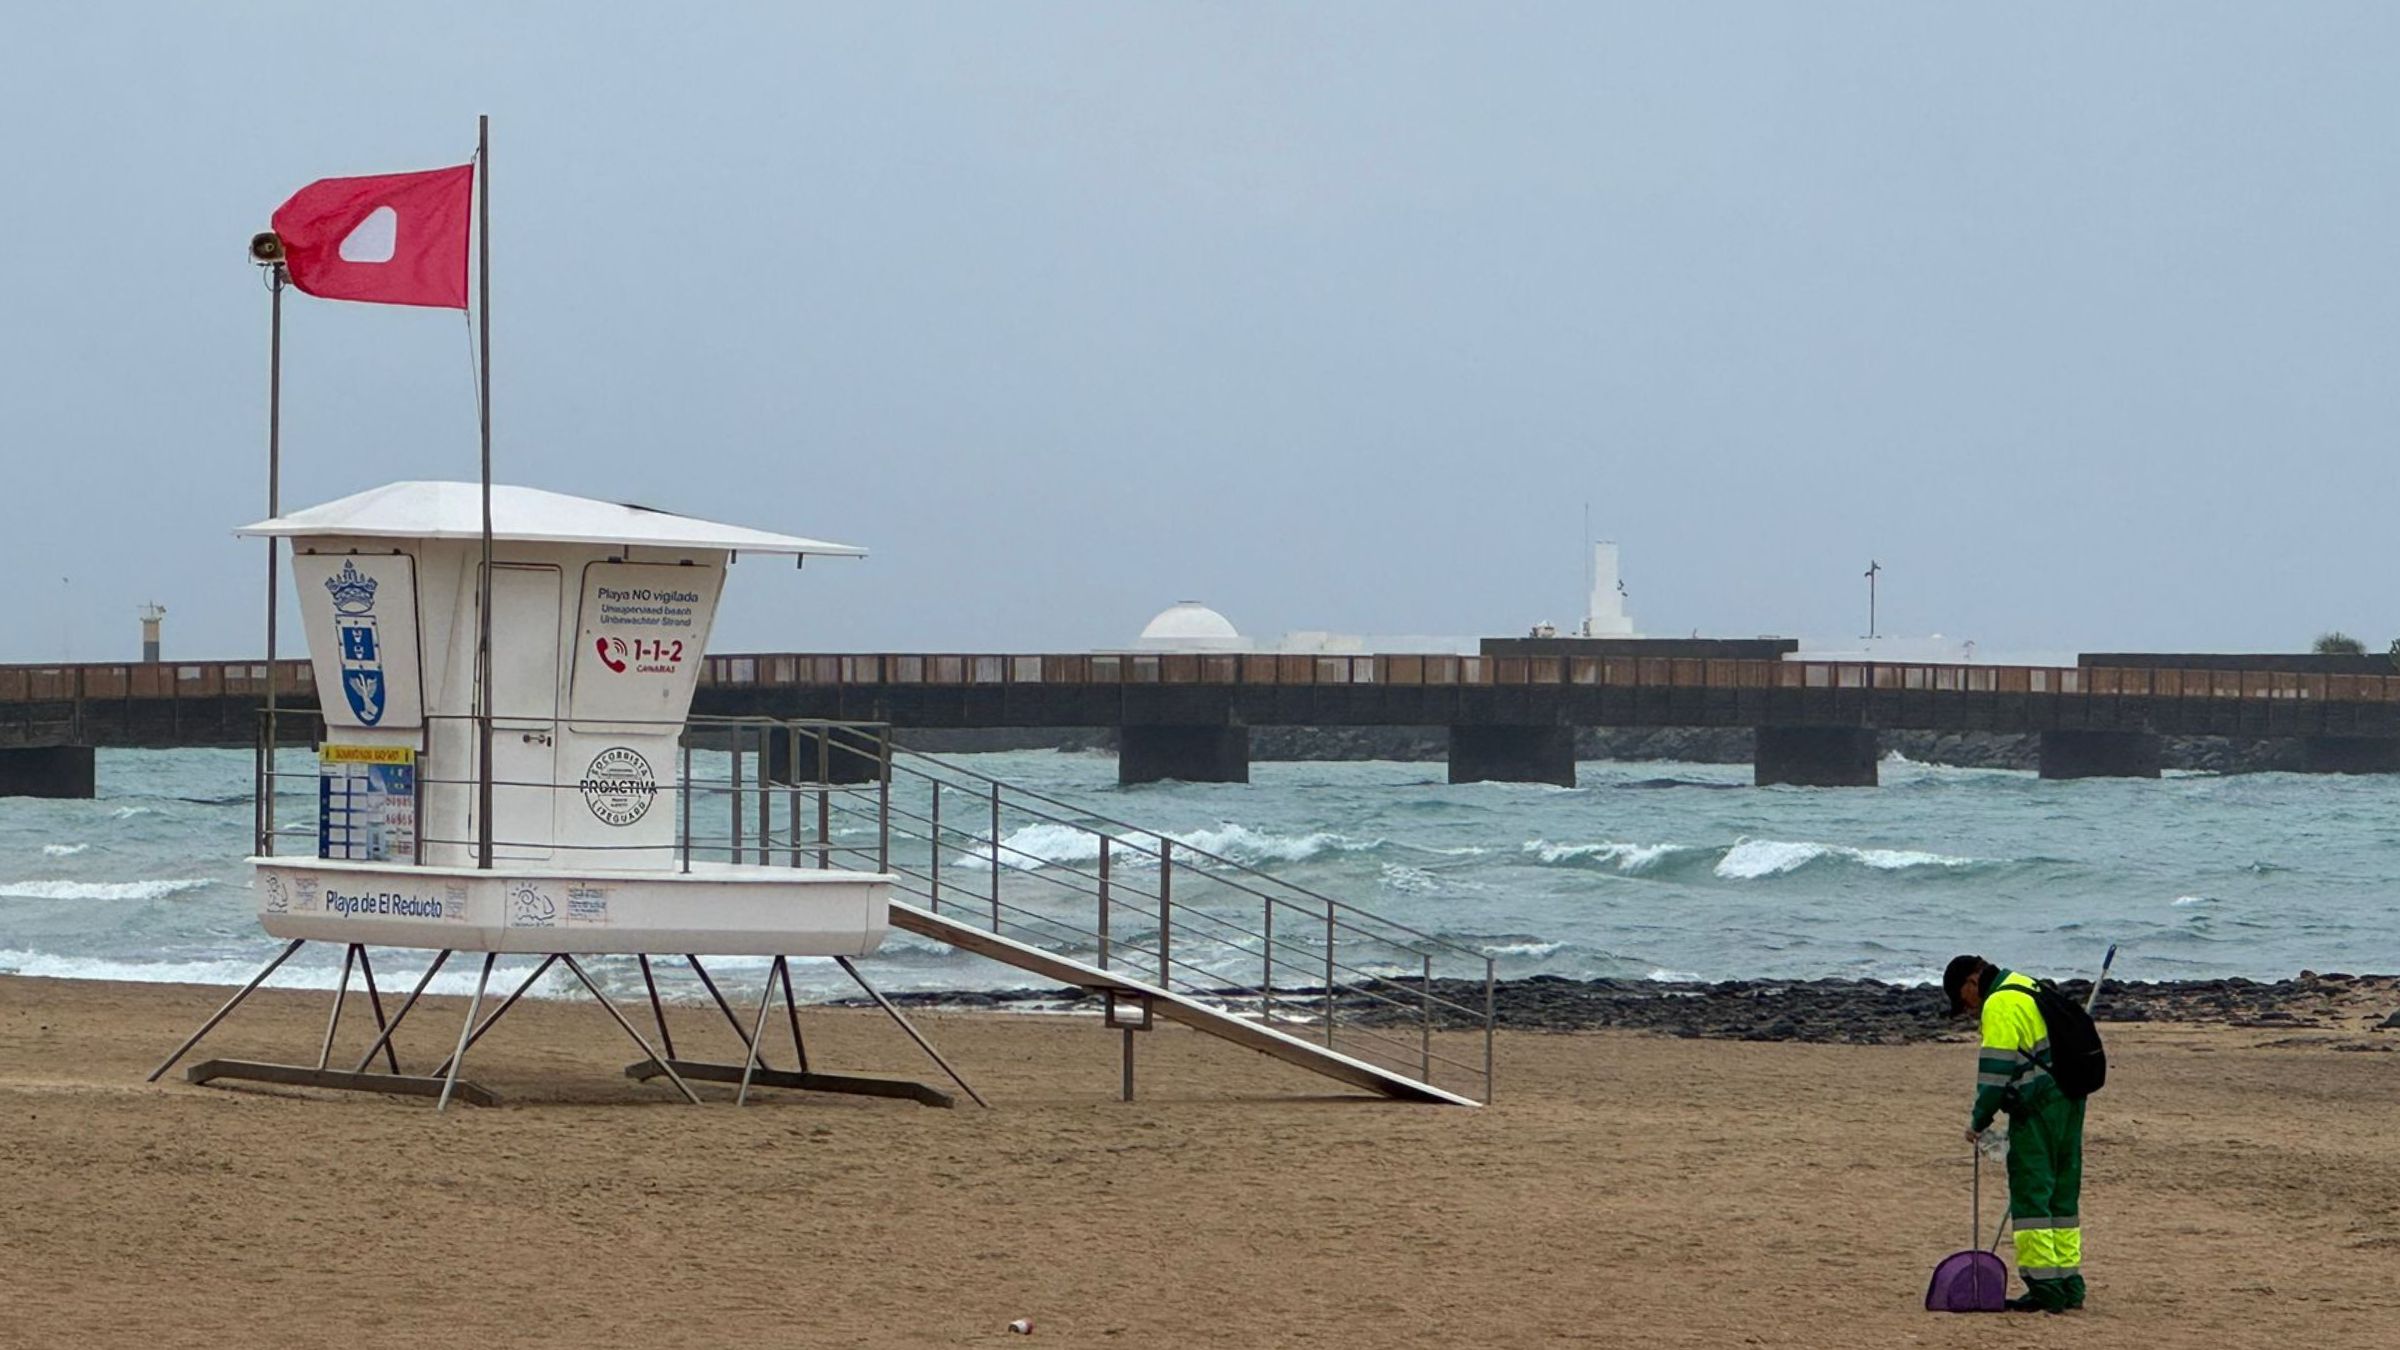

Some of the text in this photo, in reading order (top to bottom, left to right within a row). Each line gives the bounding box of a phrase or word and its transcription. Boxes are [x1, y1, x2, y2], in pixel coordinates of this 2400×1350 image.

[598, 587, 699, 604] Playa NO vigilada
[634, 639, 683, 662] 1-1-2
[580, 780, 657, 794] PROACTIVA
[326, 890, 359, 917] Playa
[361, 892, 376, 913] de
[378, 893, 390, 914] El
[392, 894, 442, 918] Reducto
